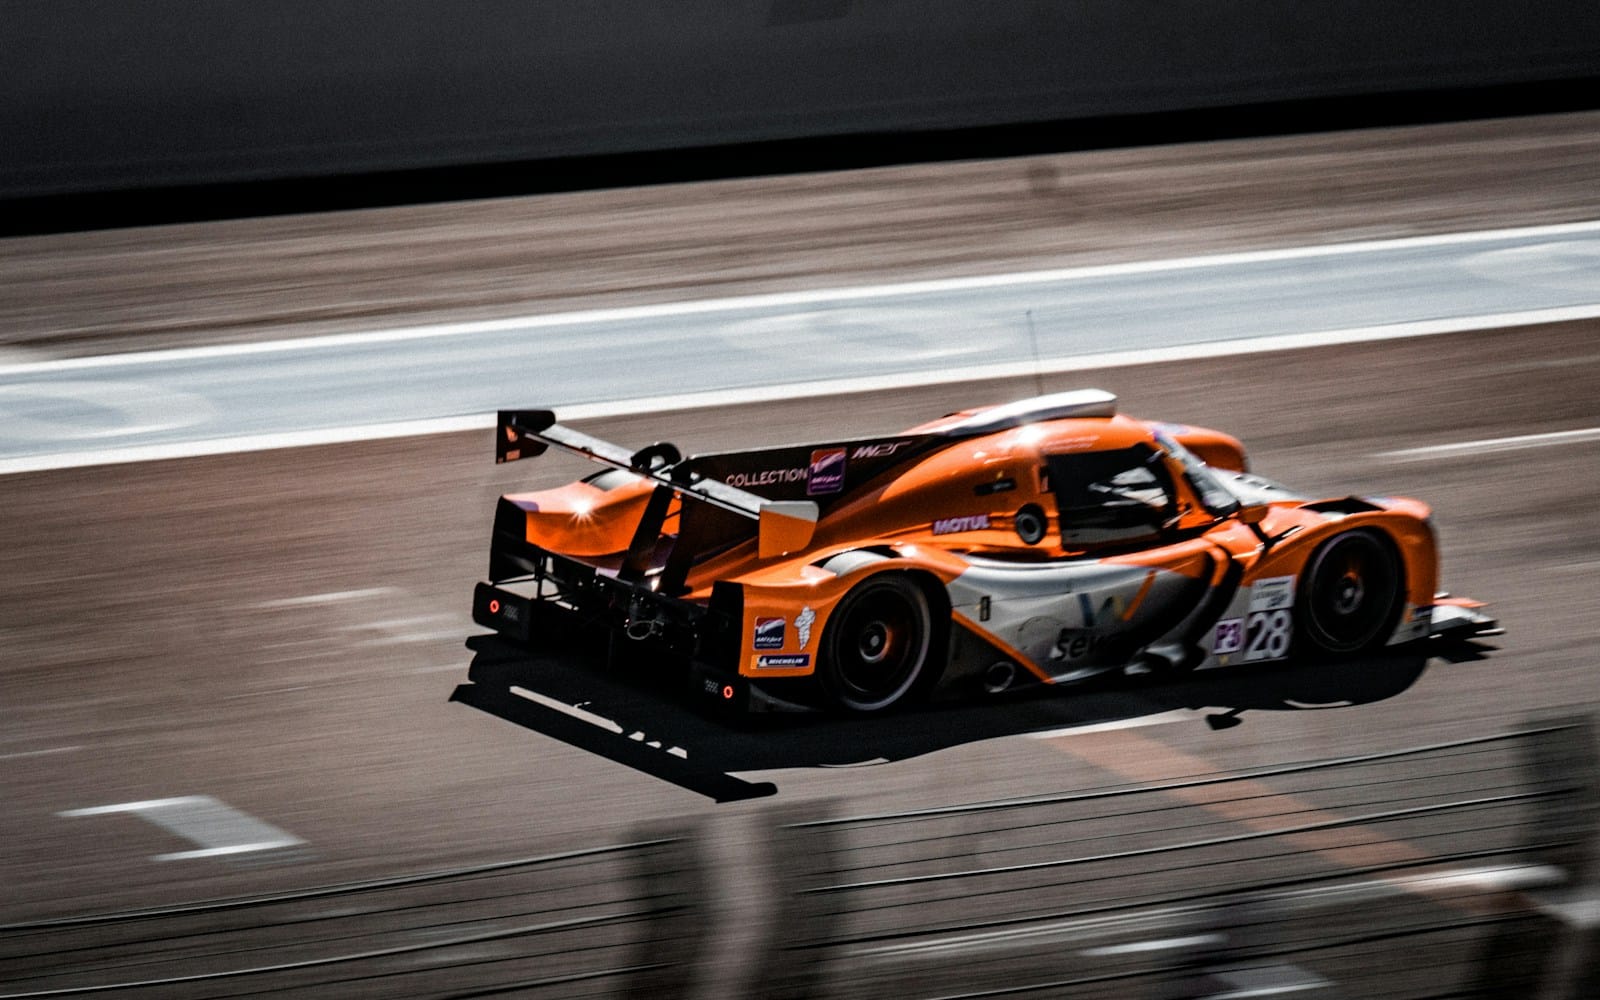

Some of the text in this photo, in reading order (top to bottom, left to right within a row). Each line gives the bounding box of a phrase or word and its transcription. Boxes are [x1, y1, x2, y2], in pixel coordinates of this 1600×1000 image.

[726, 467, 809, 488] COLLECTION
[933, 515, 991, 535] MOTUL
[1242, 609, 1290, 660] 28
